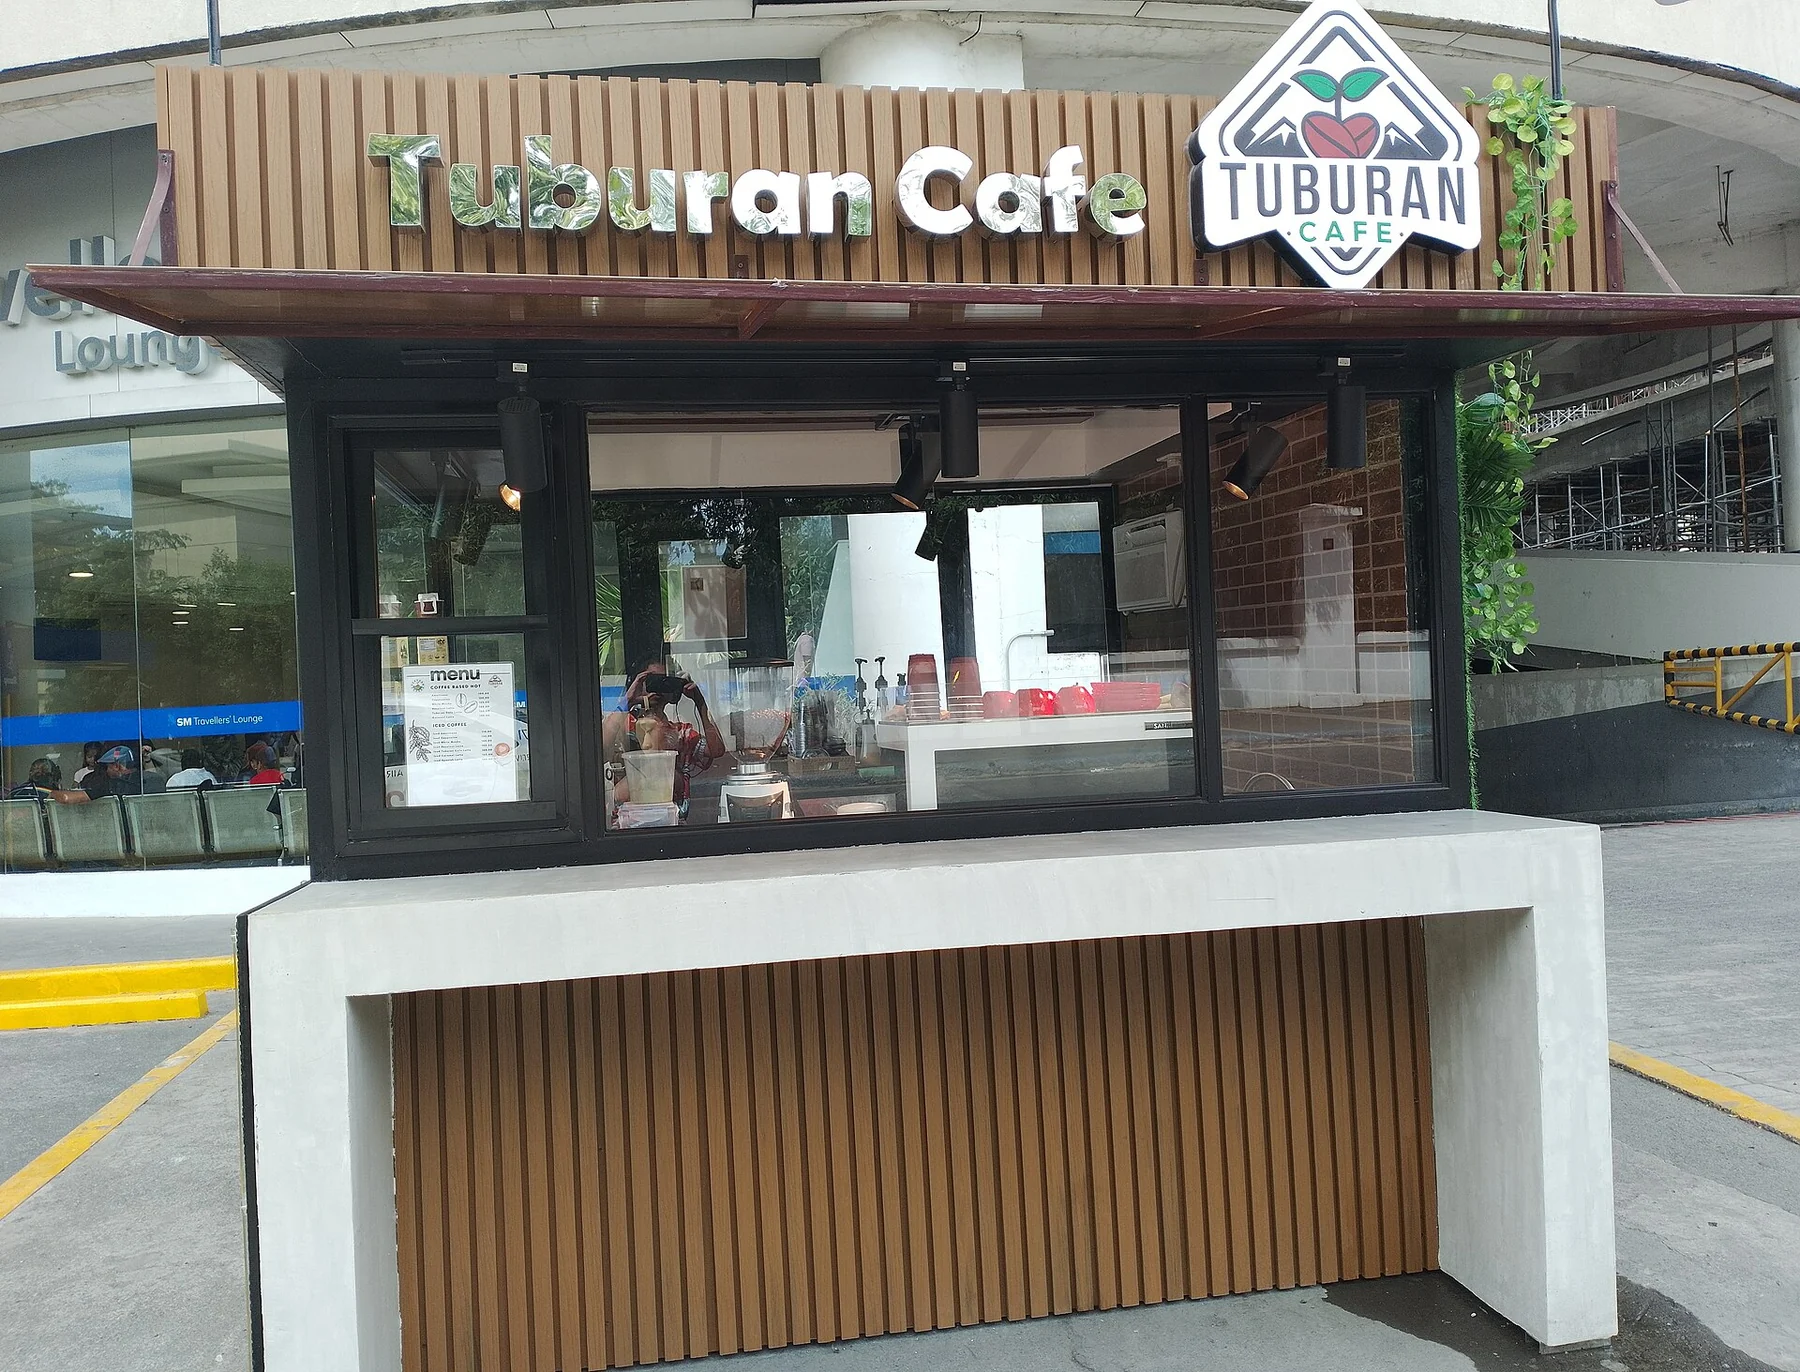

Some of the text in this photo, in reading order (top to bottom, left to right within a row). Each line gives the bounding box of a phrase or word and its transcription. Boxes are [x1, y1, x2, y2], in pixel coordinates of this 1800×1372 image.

[367, 133, 1148, 237] Tuburan Cafe
[1219, 162, 1466, 225] TUBURAN
[1298, 220, 1393, 244] CAFE
[54, 329, 222, 375] Loung
[430, 668, 481, 682] menu
[176, 715, 263, 727] SM Travellers' Lounge
